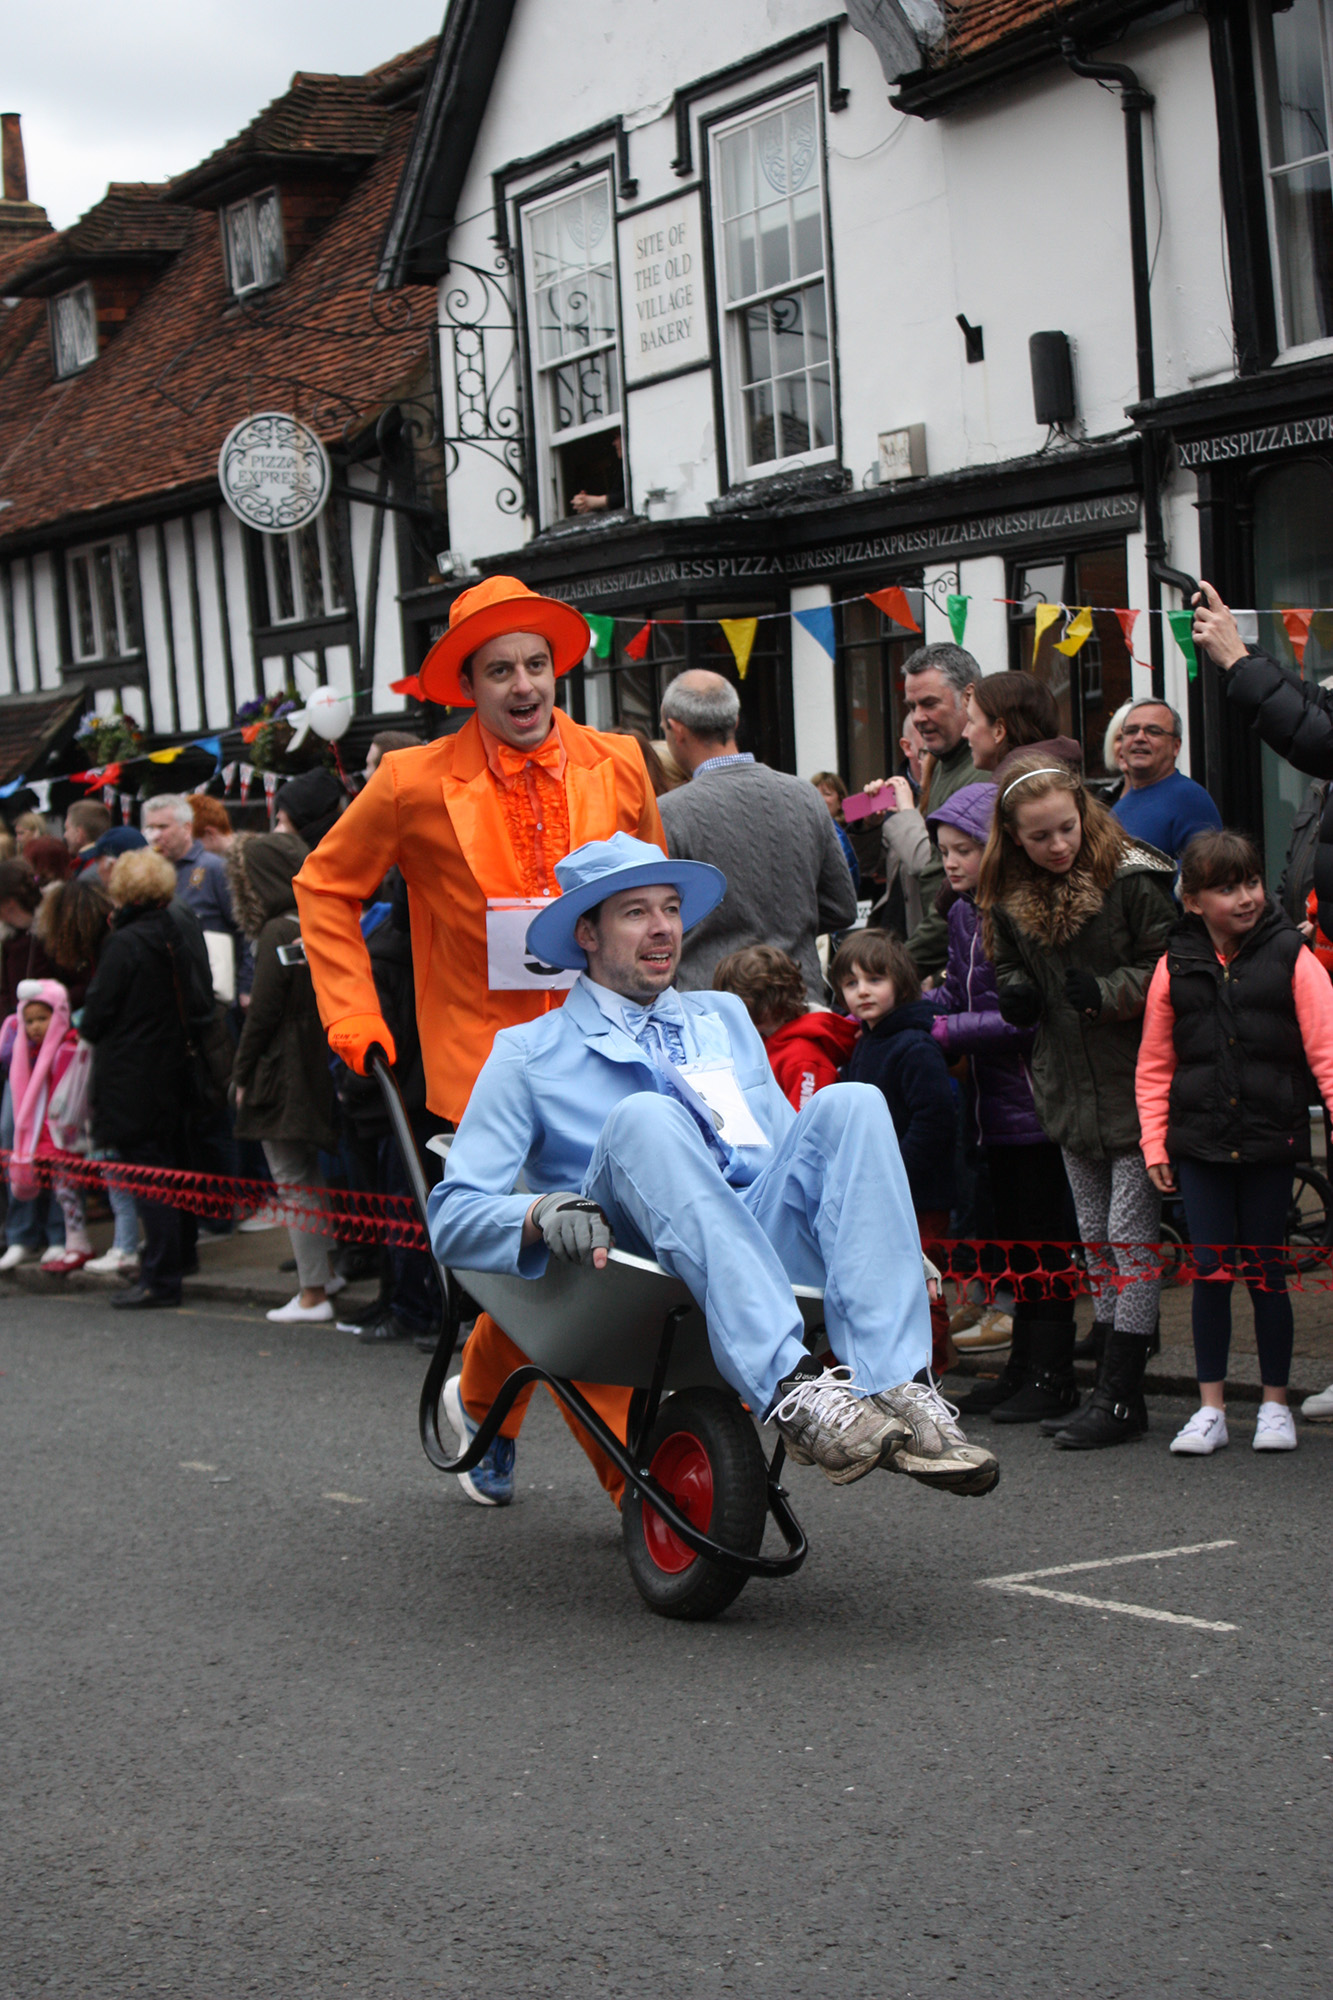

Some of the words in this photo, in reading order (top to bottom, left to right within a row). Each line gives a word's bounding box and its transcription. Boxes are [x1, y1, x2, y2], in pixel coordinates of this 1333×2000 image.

[636, 230, 665, 260] SITE
[668, 222, 687, 249] OF
[634, 263, 661, 292] THE
[664, 252, 692, 281] OLD
[636, 284, 694, 321] VILLAGE
[639, 316, 693, 353] BAKERY
[238, 469, 311, 485] EXPRESS
[250, 455, 298, 470] PIZZA
